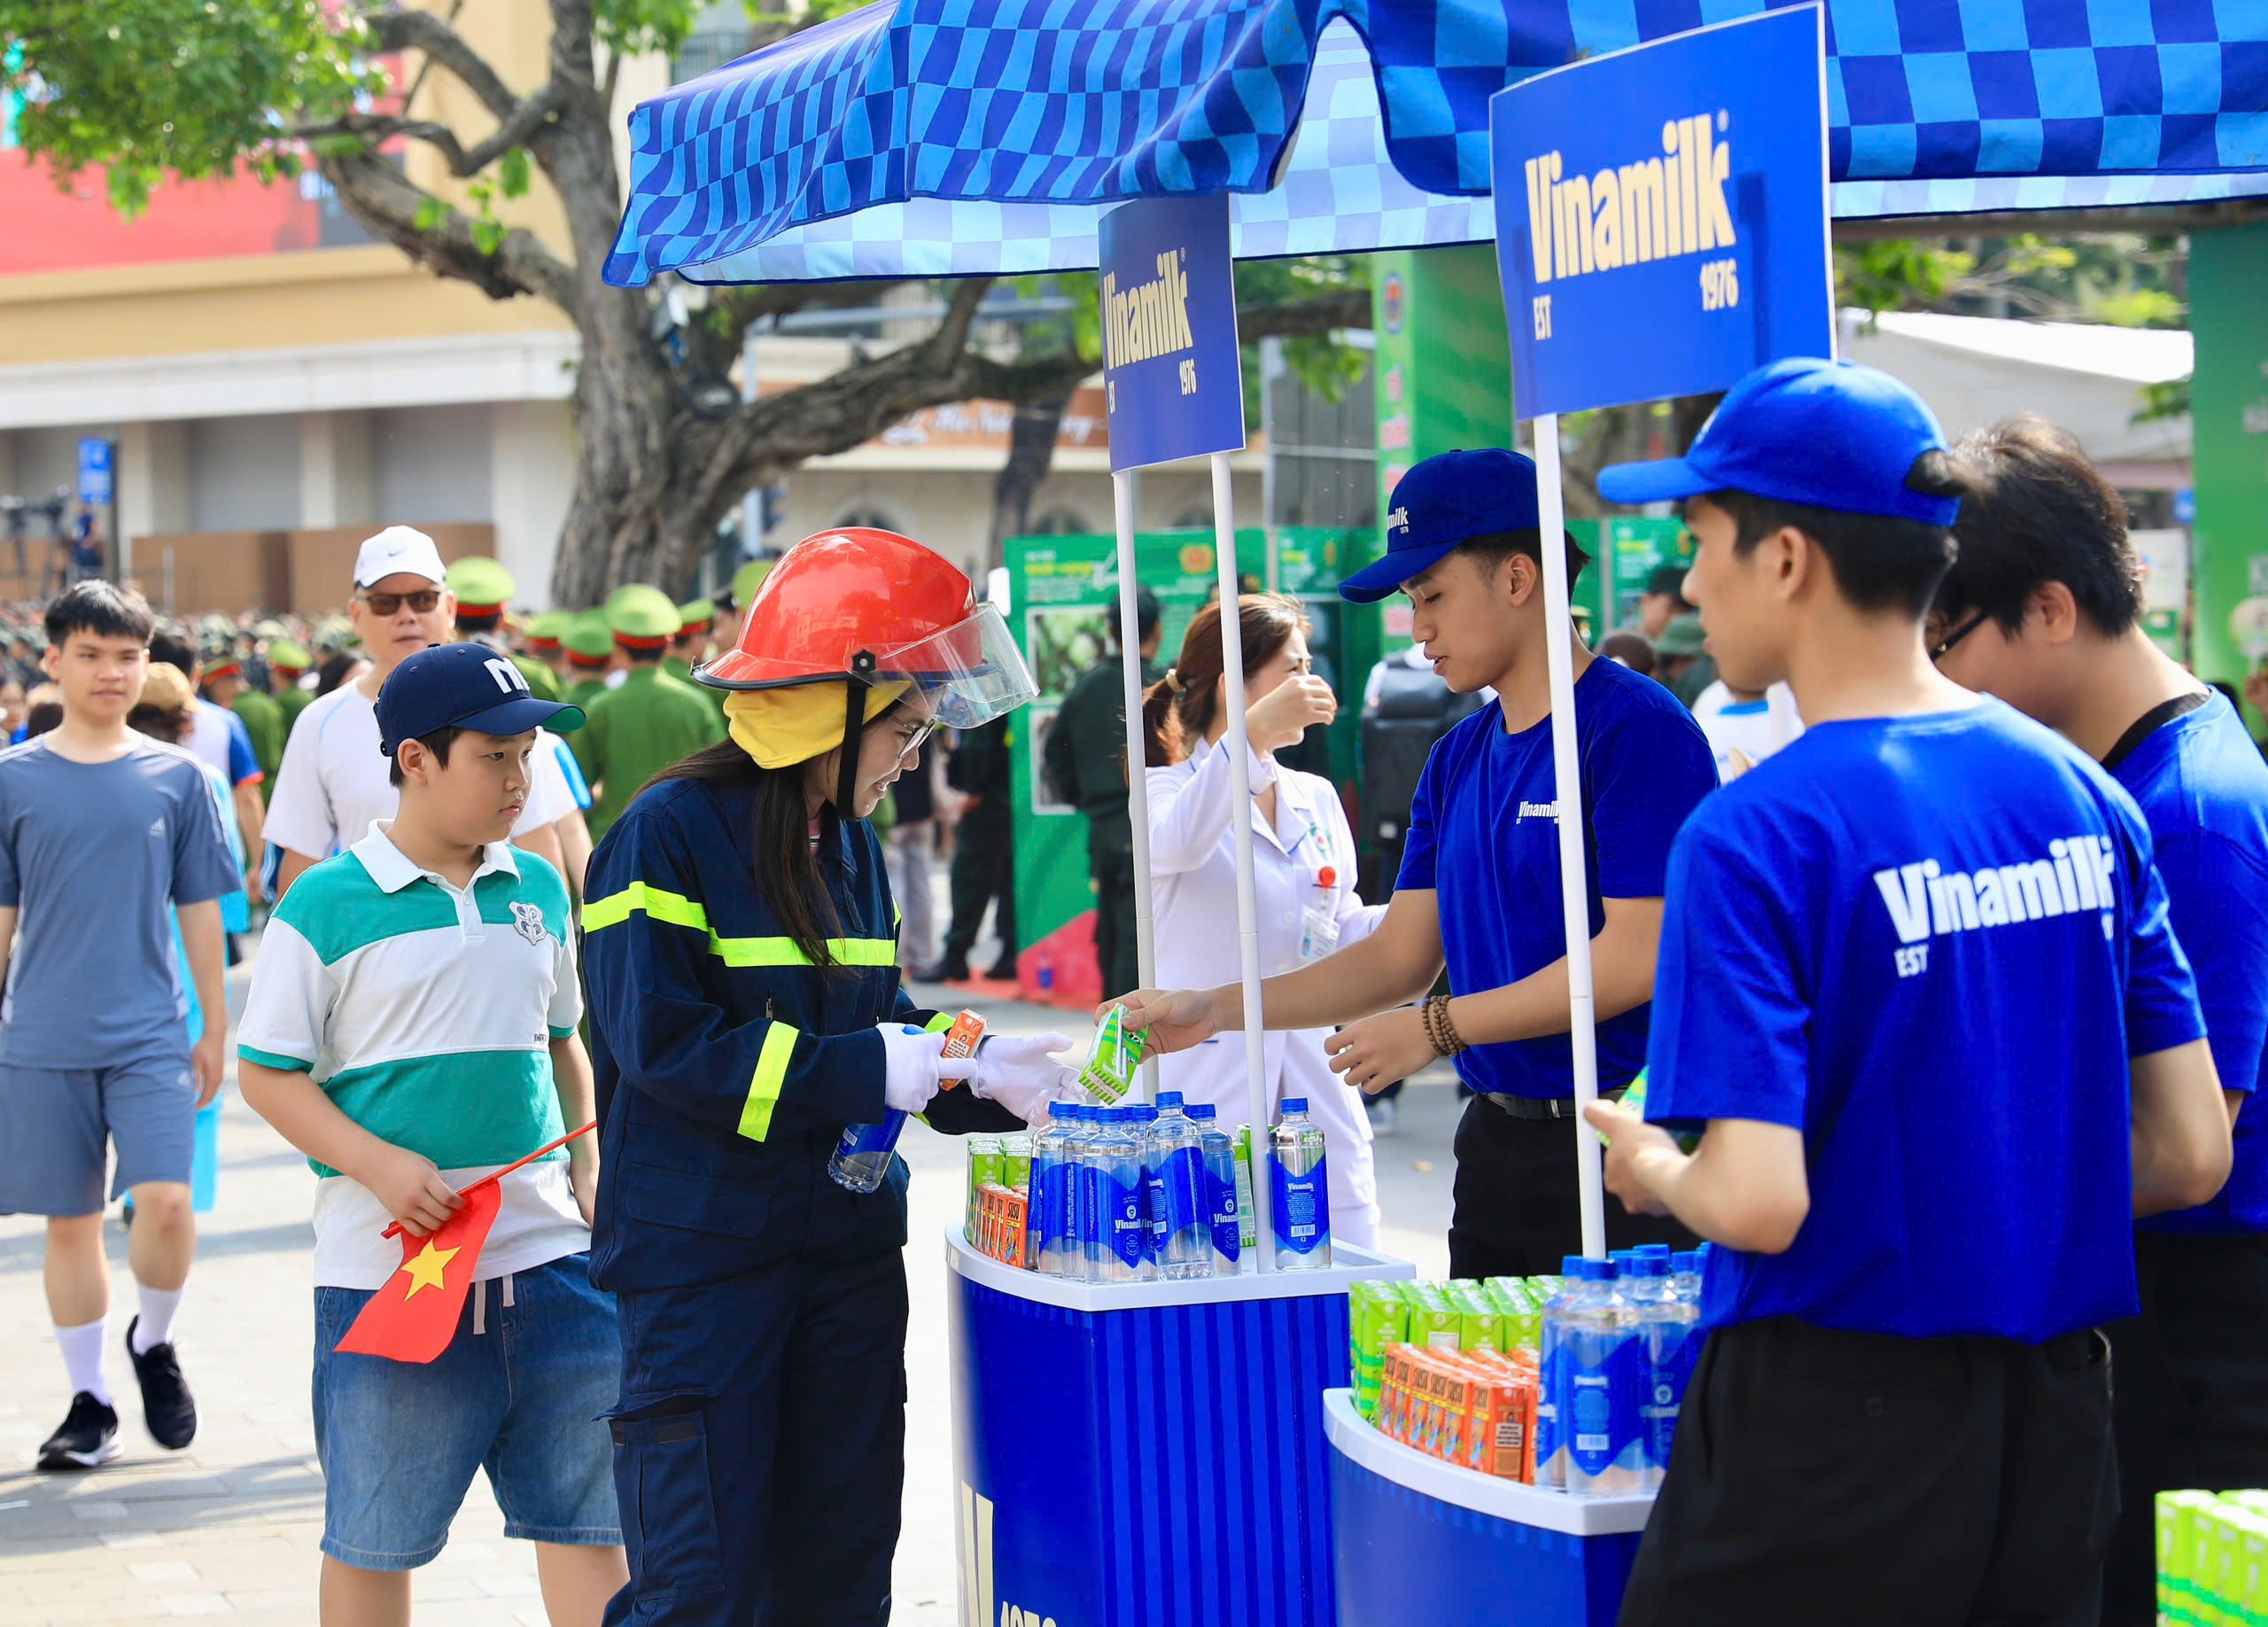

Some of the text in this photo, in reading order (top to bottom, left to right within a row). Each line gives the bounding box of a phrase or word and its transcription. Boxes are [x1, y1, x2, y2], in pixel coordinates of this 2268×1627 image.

[1525, 113, 1736, 284] Vinamilk
[1104, 250, 1193, 370] Vinamilk
[1533, 258, 1739, 340] EST 1976
[1179, 359, 1196, 395] 1976
[1894, 944, 1929, 978] EST
[1007, 1202, 1021, 1220] SUSU
